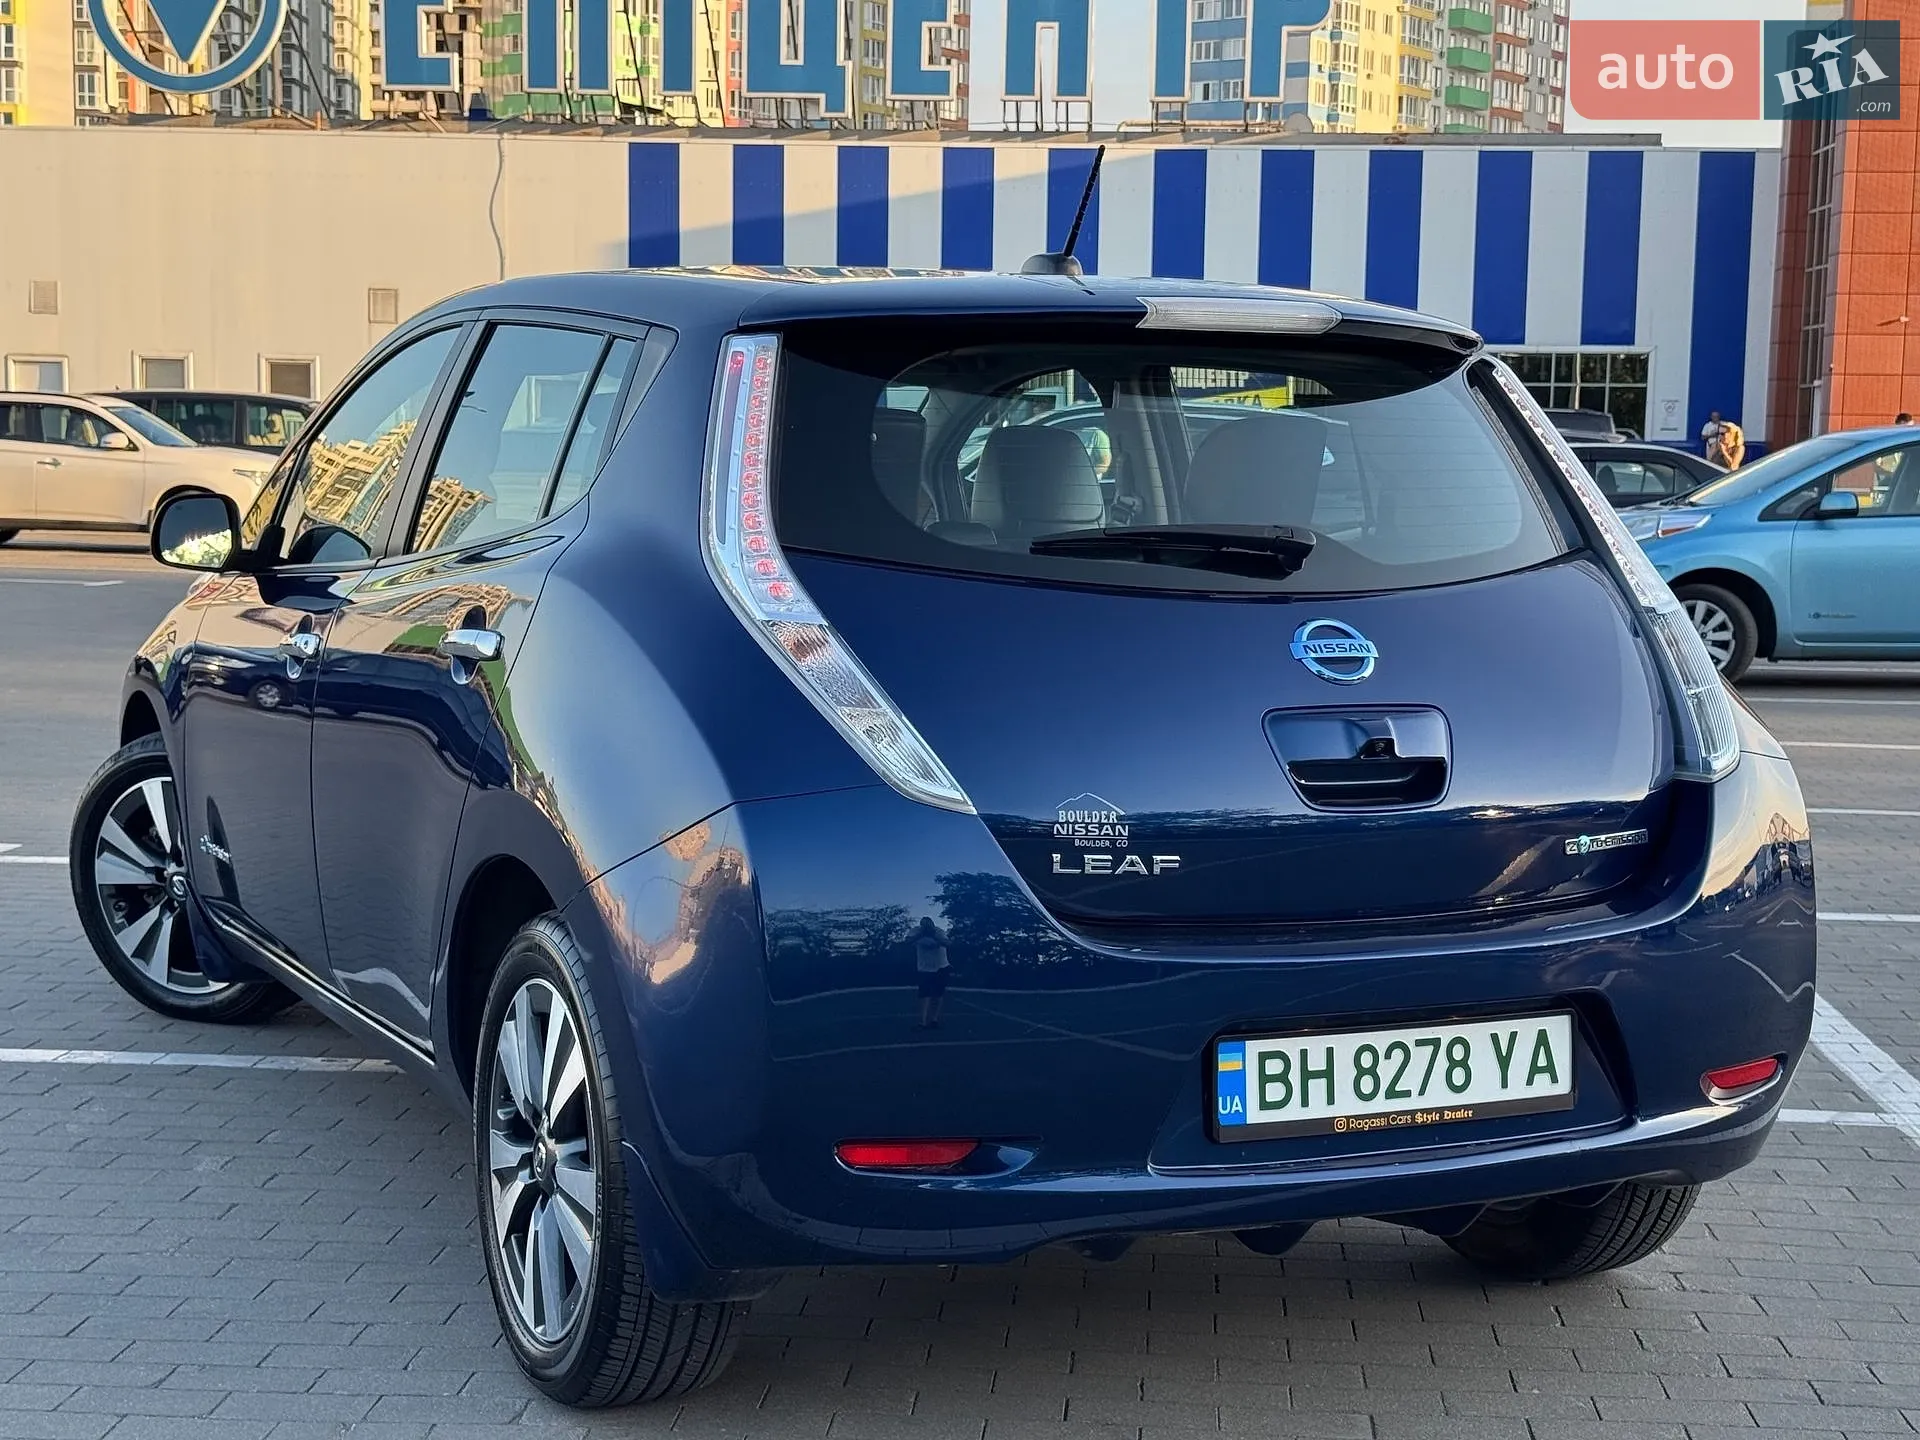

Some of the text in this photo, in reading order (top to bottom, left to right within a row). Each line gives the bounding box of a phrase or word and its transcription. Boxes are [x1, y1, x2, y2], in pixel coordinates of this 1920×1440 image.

[1302, 643, 1372, 655] NISSAN
[1058, 810, 1118, 824] BOULDER
[1053, 824, 1129, 837] NISSAN
[1074, 839, 1129, 849] BOULDER, CO
[1051, 853, 1181, 875] LEAF
[1258, 1028, 1559, 1111] BH 8278 YA
[1219, 1095, 1243, 1115] UA
[1349, 1118, 1388, 1131] Ragassi
[1389, 1114, 1412, 1126] Cars
[1443, 1108, 1473, 1120] Dealer
